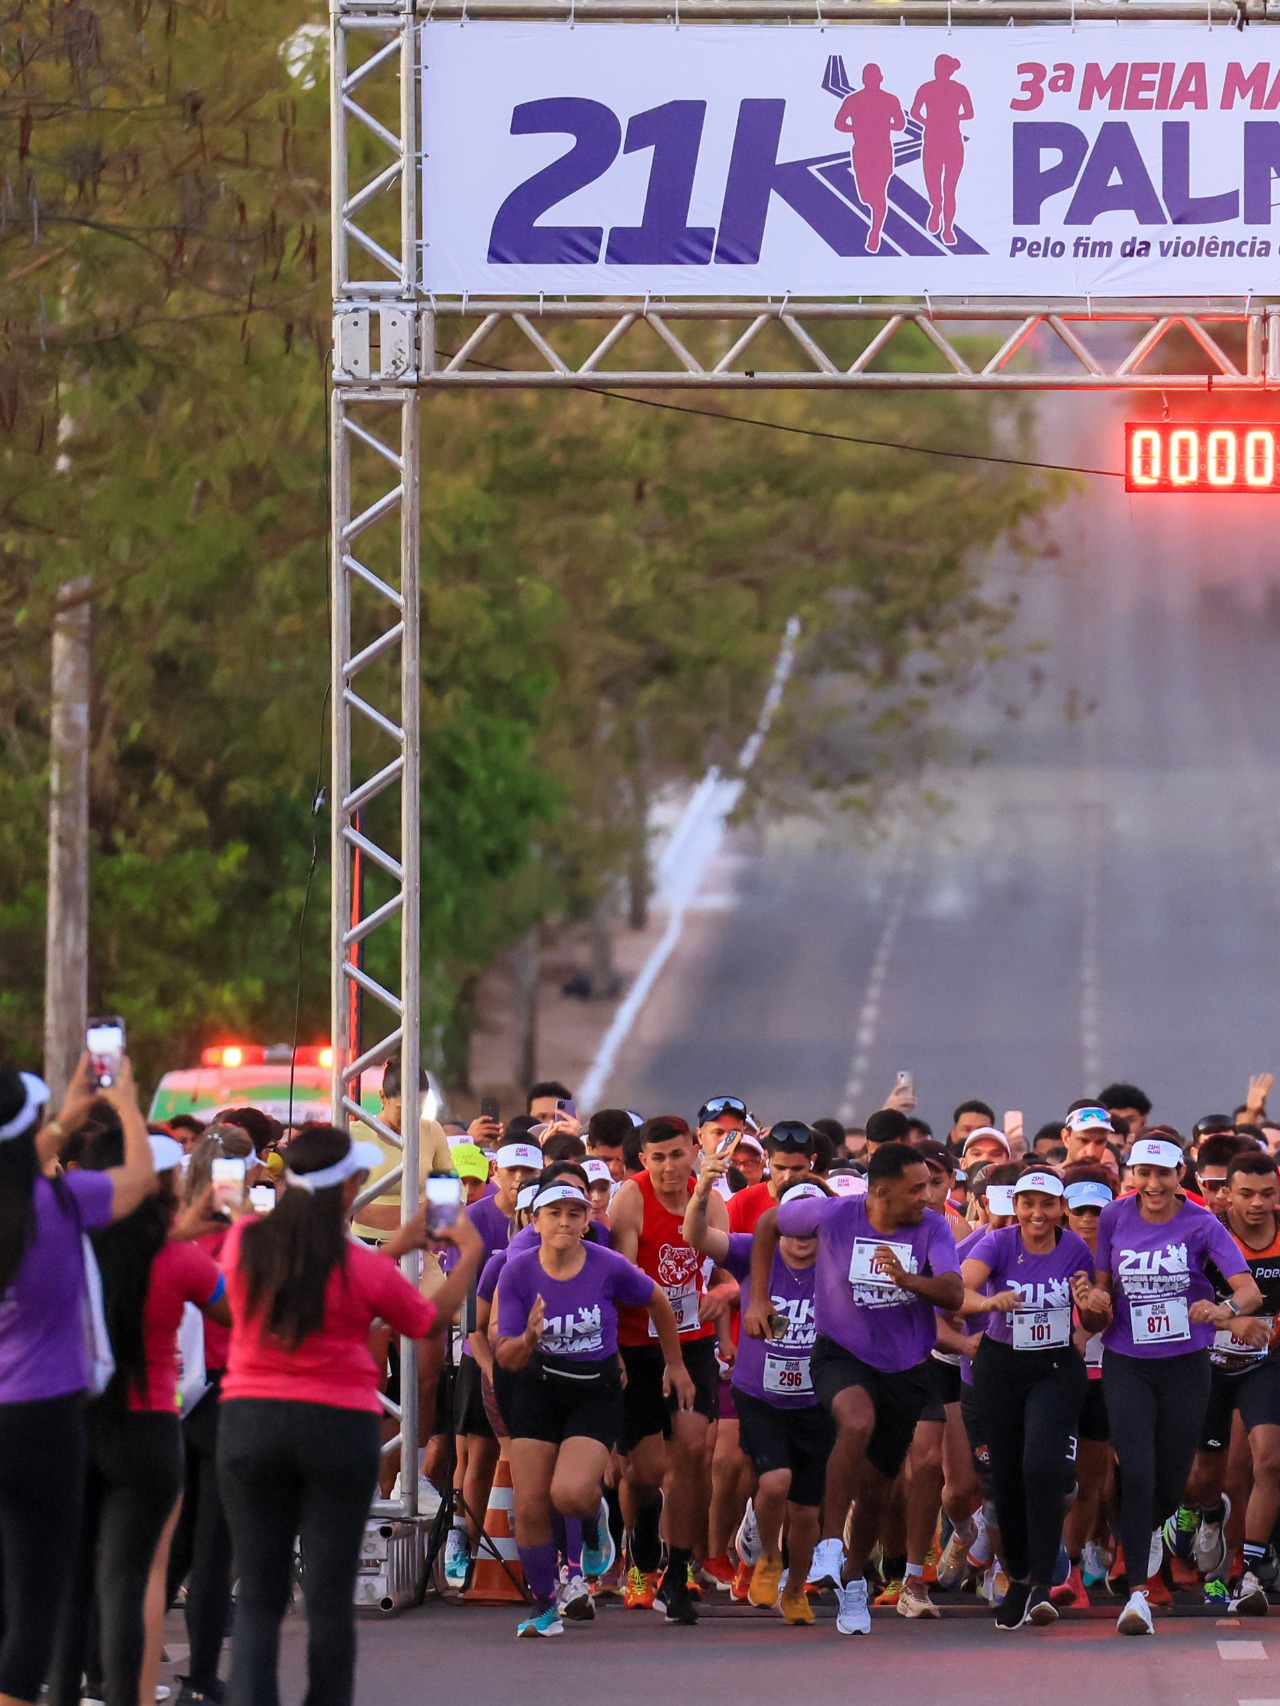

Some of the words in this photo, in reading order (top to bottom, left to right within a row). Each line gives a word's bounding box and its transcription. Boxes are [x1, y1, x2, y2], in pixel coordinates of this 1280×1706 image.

[1079, 62, 1208, 110] MEIA
[487, 97, 989, 265] 21K
[1010, 237, 1065, 258] Pelo
[1072, 237, 1113, 258] fim
[1120, 237, 1151, 258] da
[1159, 236, 1271, 258] violência
[1118, 1249, 1190, 1276] 21K
[1030, 1324, 1051, 1341] 101
[1147, 1315, 1170, 1333] 871
[779, 1371, 802, 1387] 296
